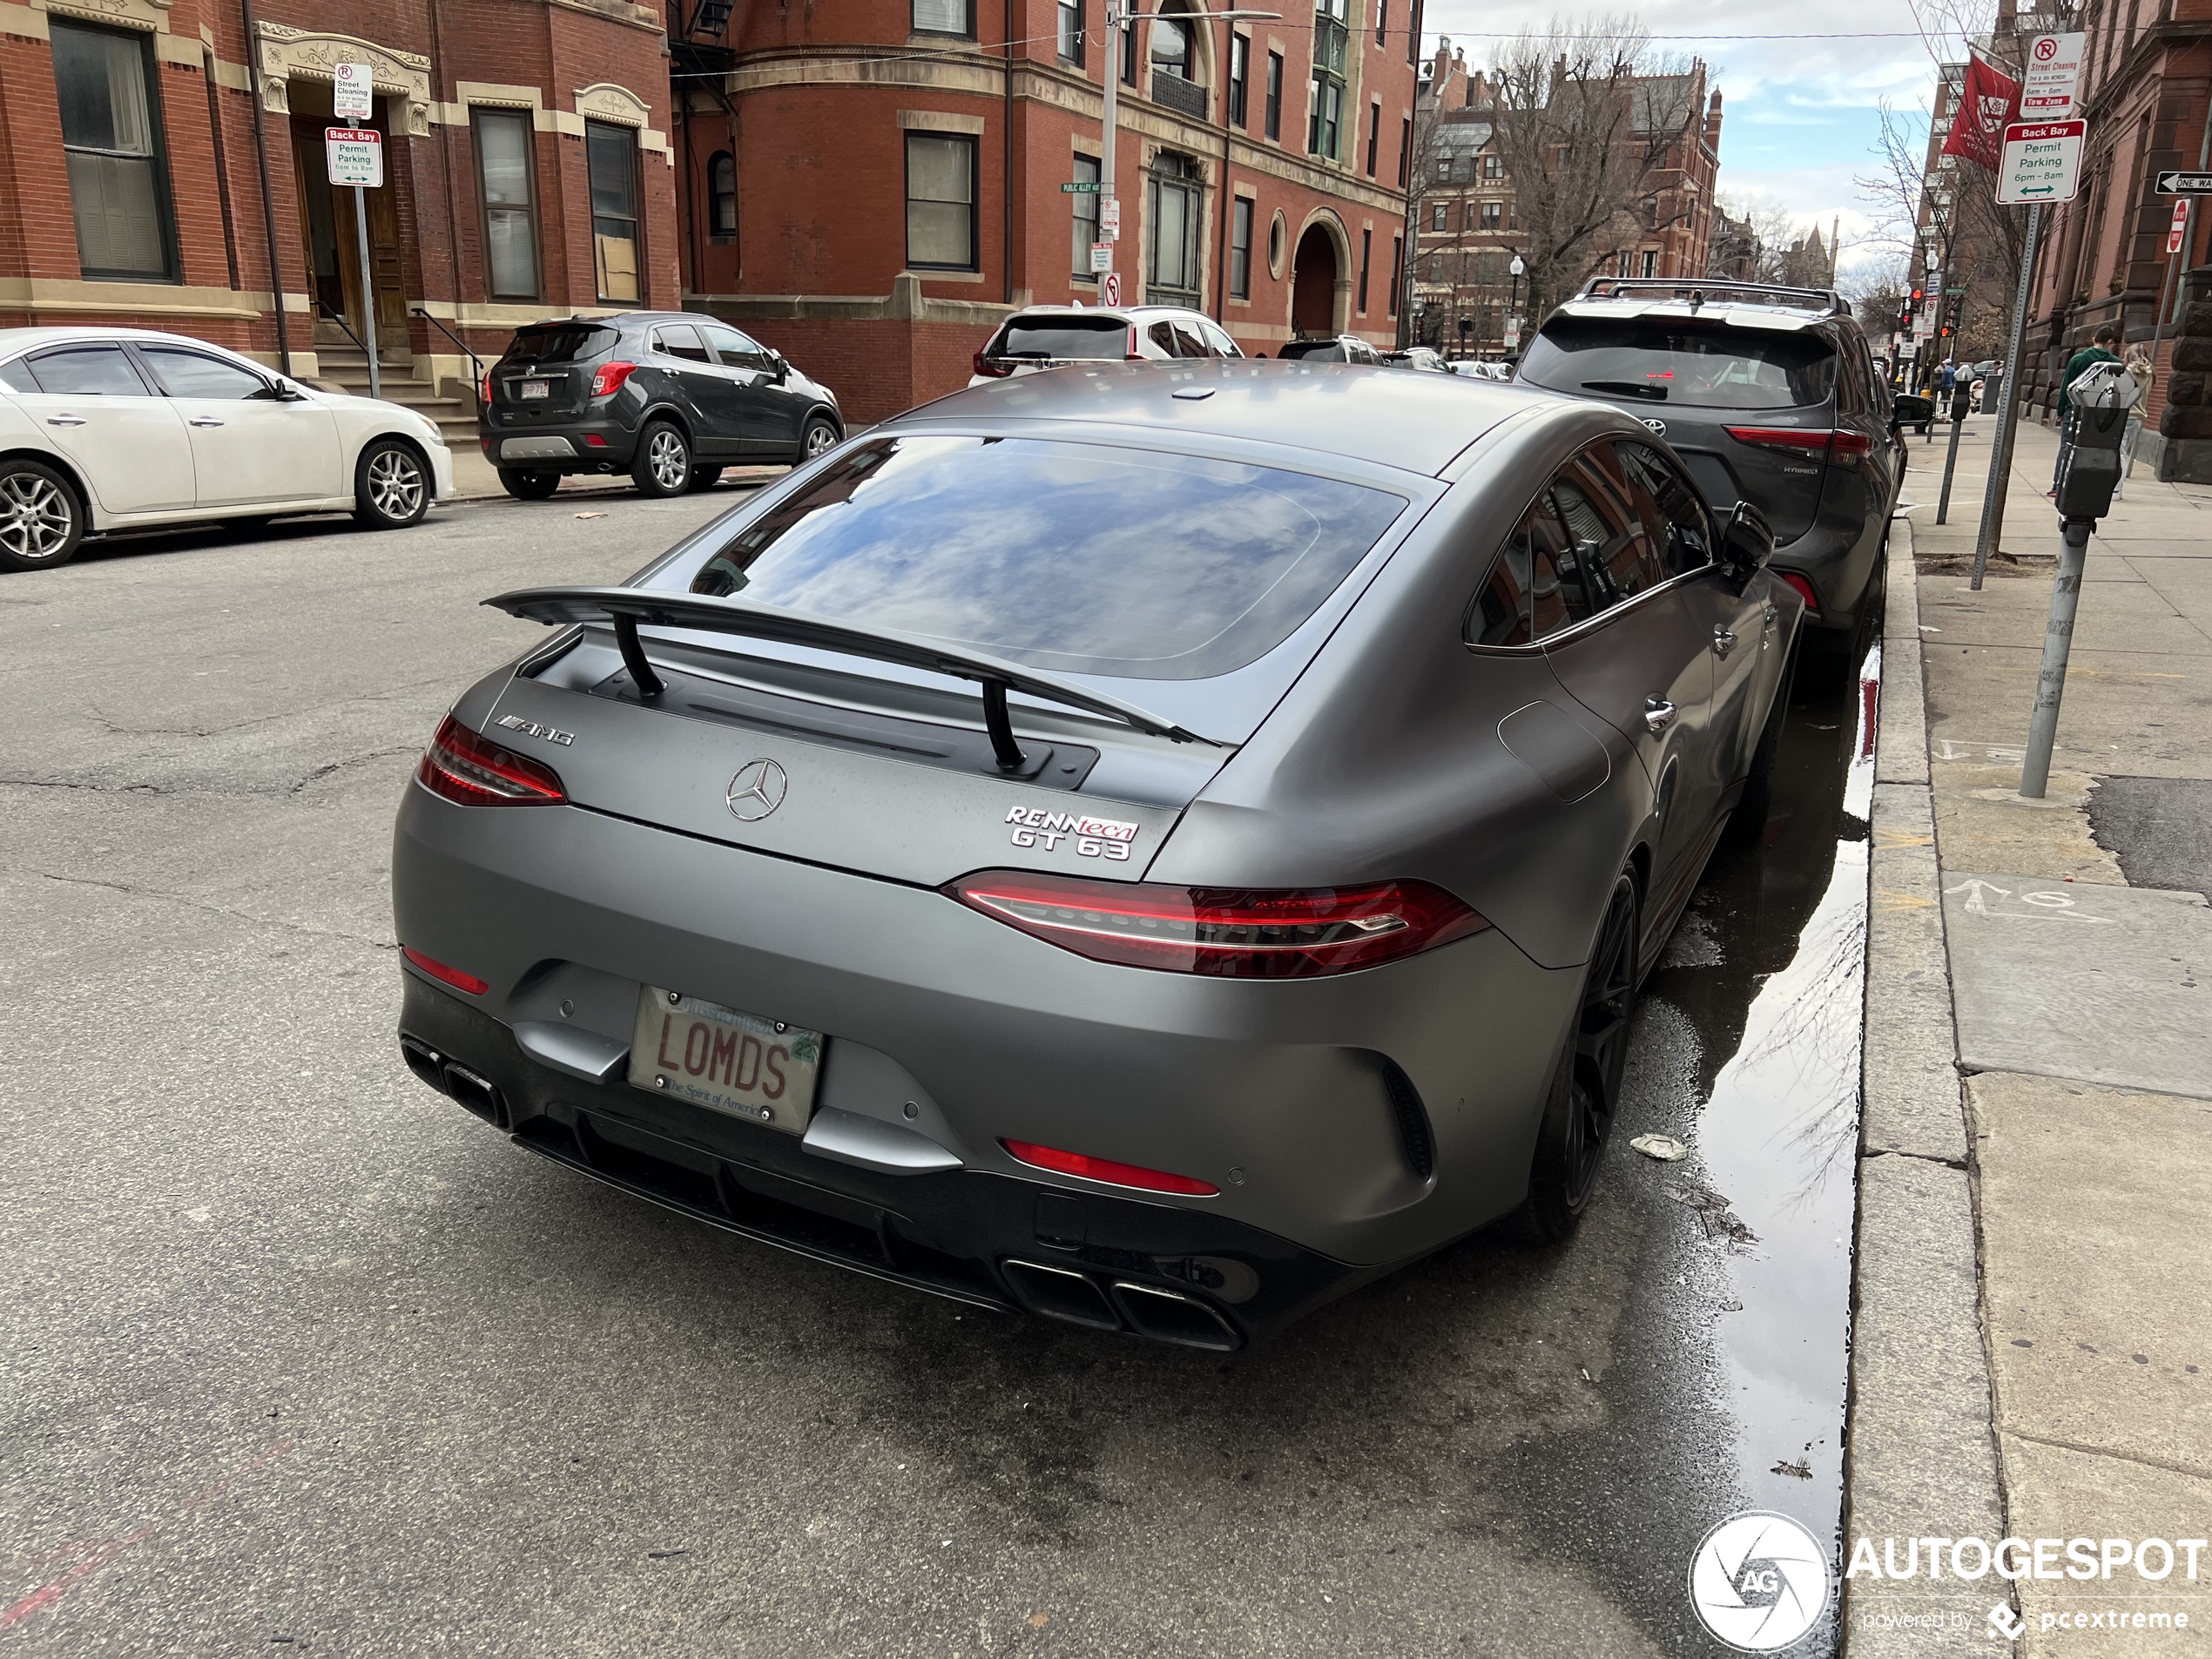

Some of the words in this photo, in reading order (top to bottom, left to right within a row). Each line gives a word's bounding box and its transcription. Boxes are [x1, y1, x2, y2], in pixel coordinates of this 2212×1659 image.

[2031, 63, 2051, 71] Street
[2053, 62, 2077, 71] Cleaning
[337, 87, 368, 97] Cleaning
[330, 130, 354, 140] Back
[357, 132, 374, 142] Bay
[2022, 128, 2047, 138] Back
[2050, 126, 2069, 136] Bay
[340, 144, 368, 153] Permit
[2025, 142, 2061, 153] Permit
[338, 154, 371, 165] Parking
[2020, 157, 2062, 168] Parking
[2014, 173, 2035, 182] 6pm
[2176, 179, 2195, 187] ONE
[536, 385, 548, 395] 712
[1011, 827, 1066, 851] GT
[1077, 837, 1130, 861] 63
[658, 1014, 790, 1100] LOMDS
[667, 1078, 684, 1093] The
[685, 1084, 711, 1101] Spirit
[712, 1093, 723, 1104] of
